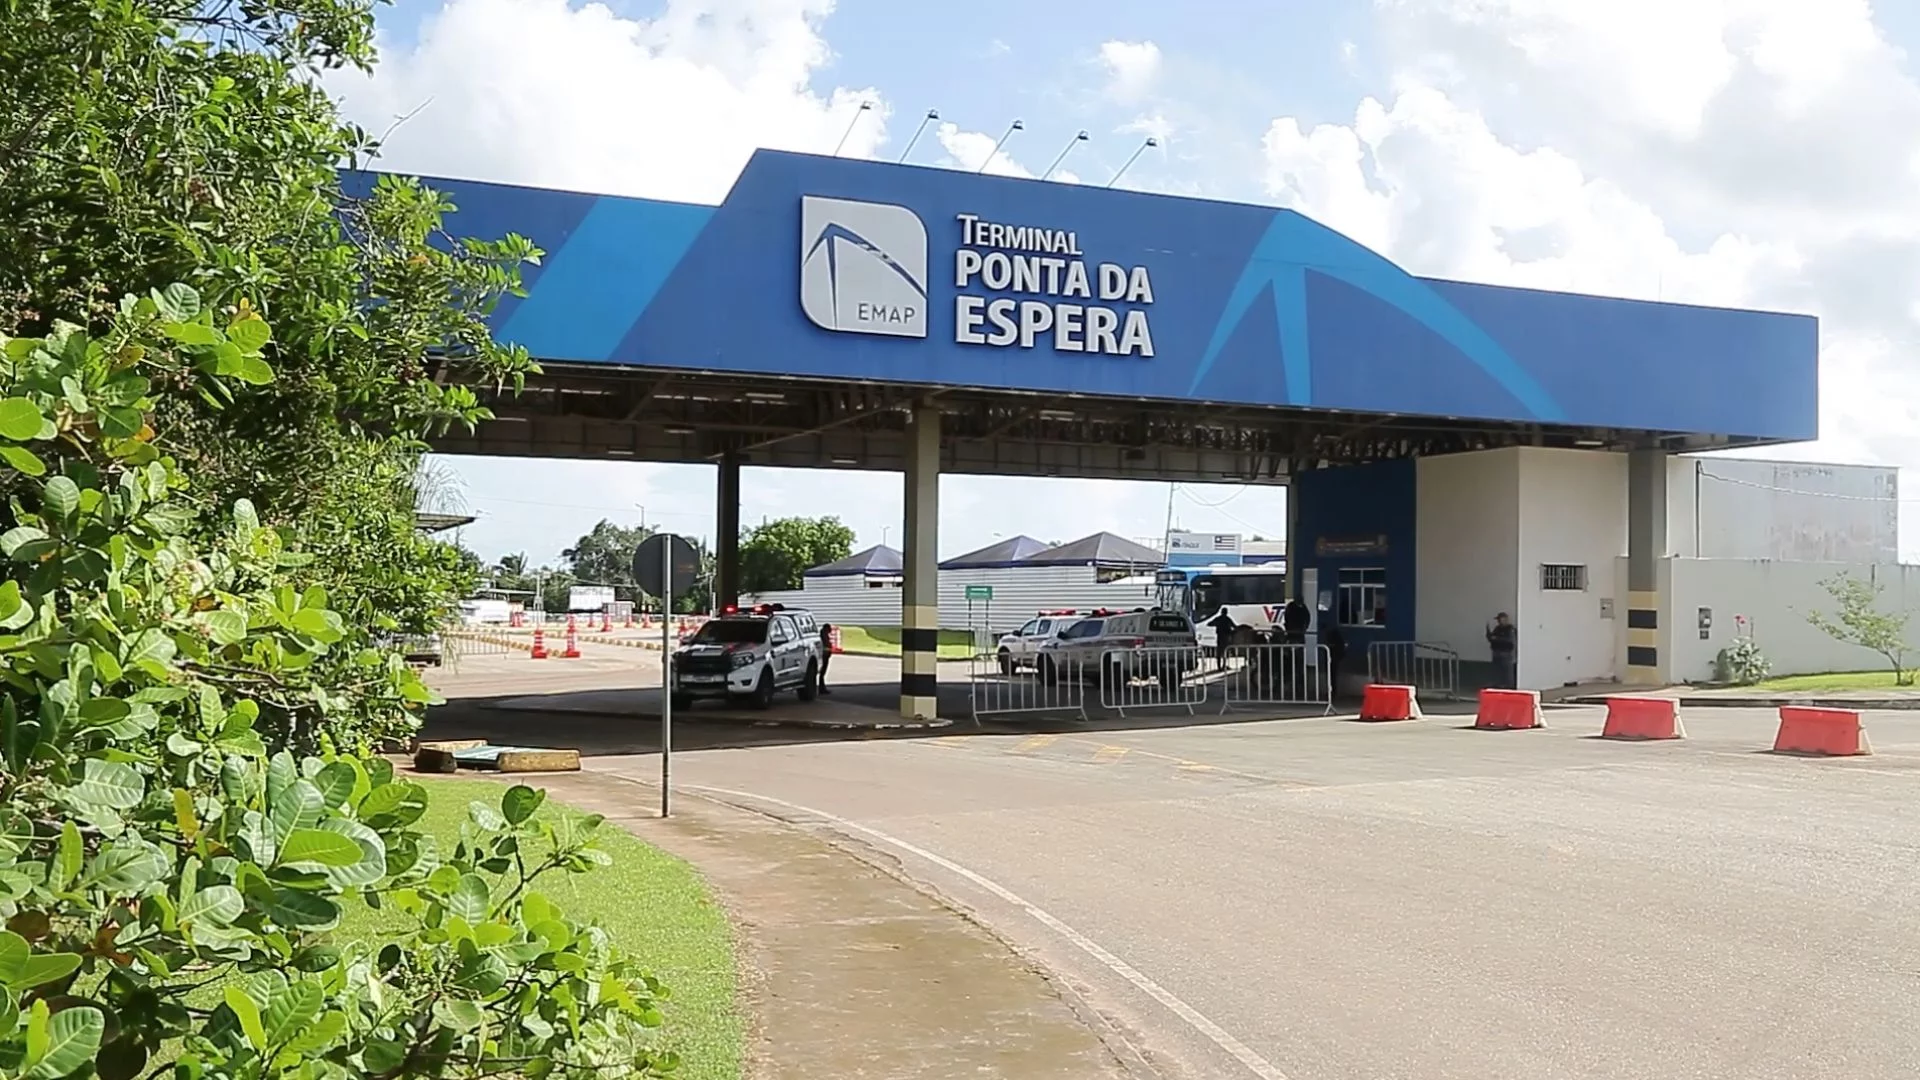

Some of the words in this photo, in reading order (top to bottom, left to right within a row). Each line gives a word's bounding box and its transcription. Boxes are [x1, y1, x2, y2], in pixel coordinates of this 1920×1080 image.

[957, 213, 1083, 256] TERMINAL
[955, 249, 1091, 298] PONTA
[1099, 262, 1154, 303] DA
[858, 303, 916, 325] EMAP
[955, 295, 1154, 357] ESPERA
